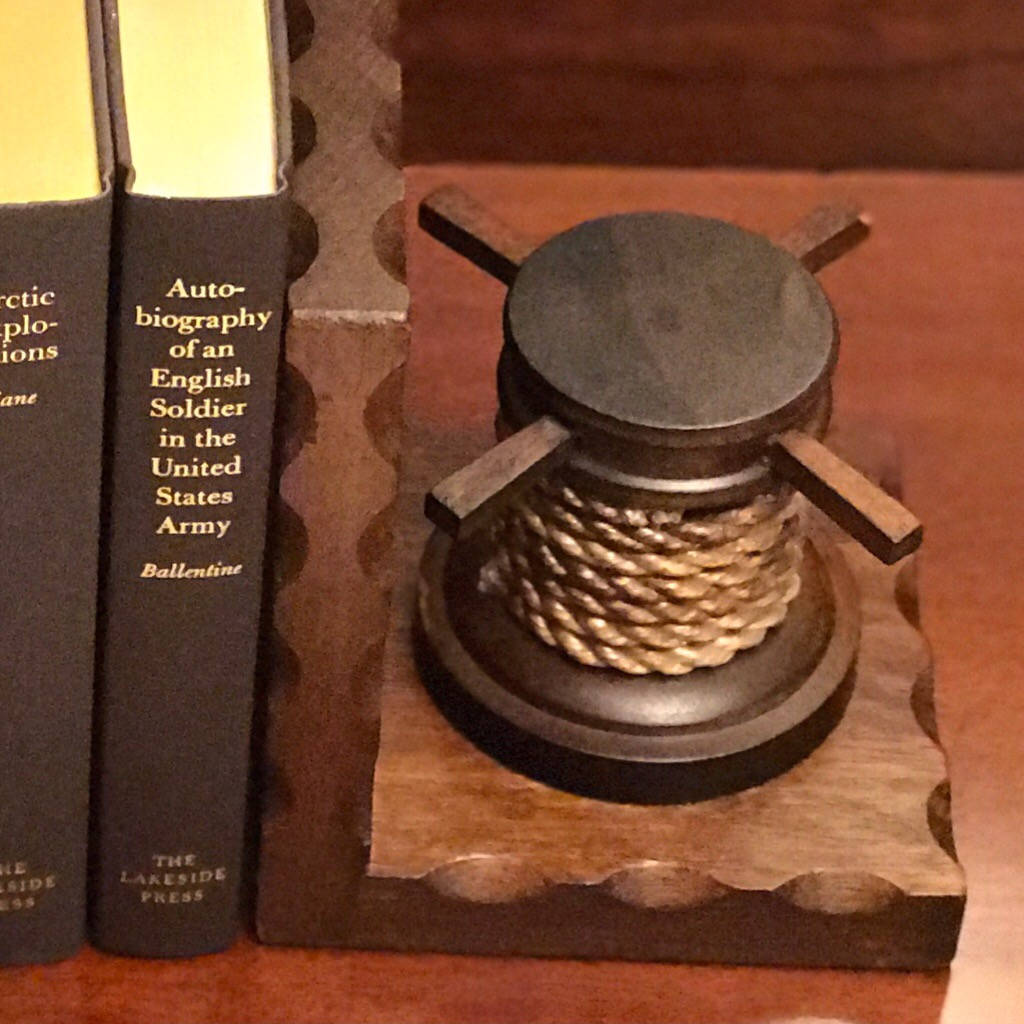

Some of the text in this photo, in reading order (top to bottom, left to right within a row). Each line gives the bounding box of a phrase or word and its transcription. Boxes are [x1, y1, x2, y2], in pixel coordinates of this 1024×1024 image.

[165, 278, 246, 299] Auto-
[135, 305, 273, 335] biography
[169, 339, 236, 360] of an
[149, 366, 252, 395] English
[149, 398, 248, 419] Soldier
[159, 427, 237, 449] in the
[151, 454, 242, 478] United
[155, 486, 234, 507] States
[155, 515, 232, 539] Army
[139, 560, 243, 579] Ballentine
